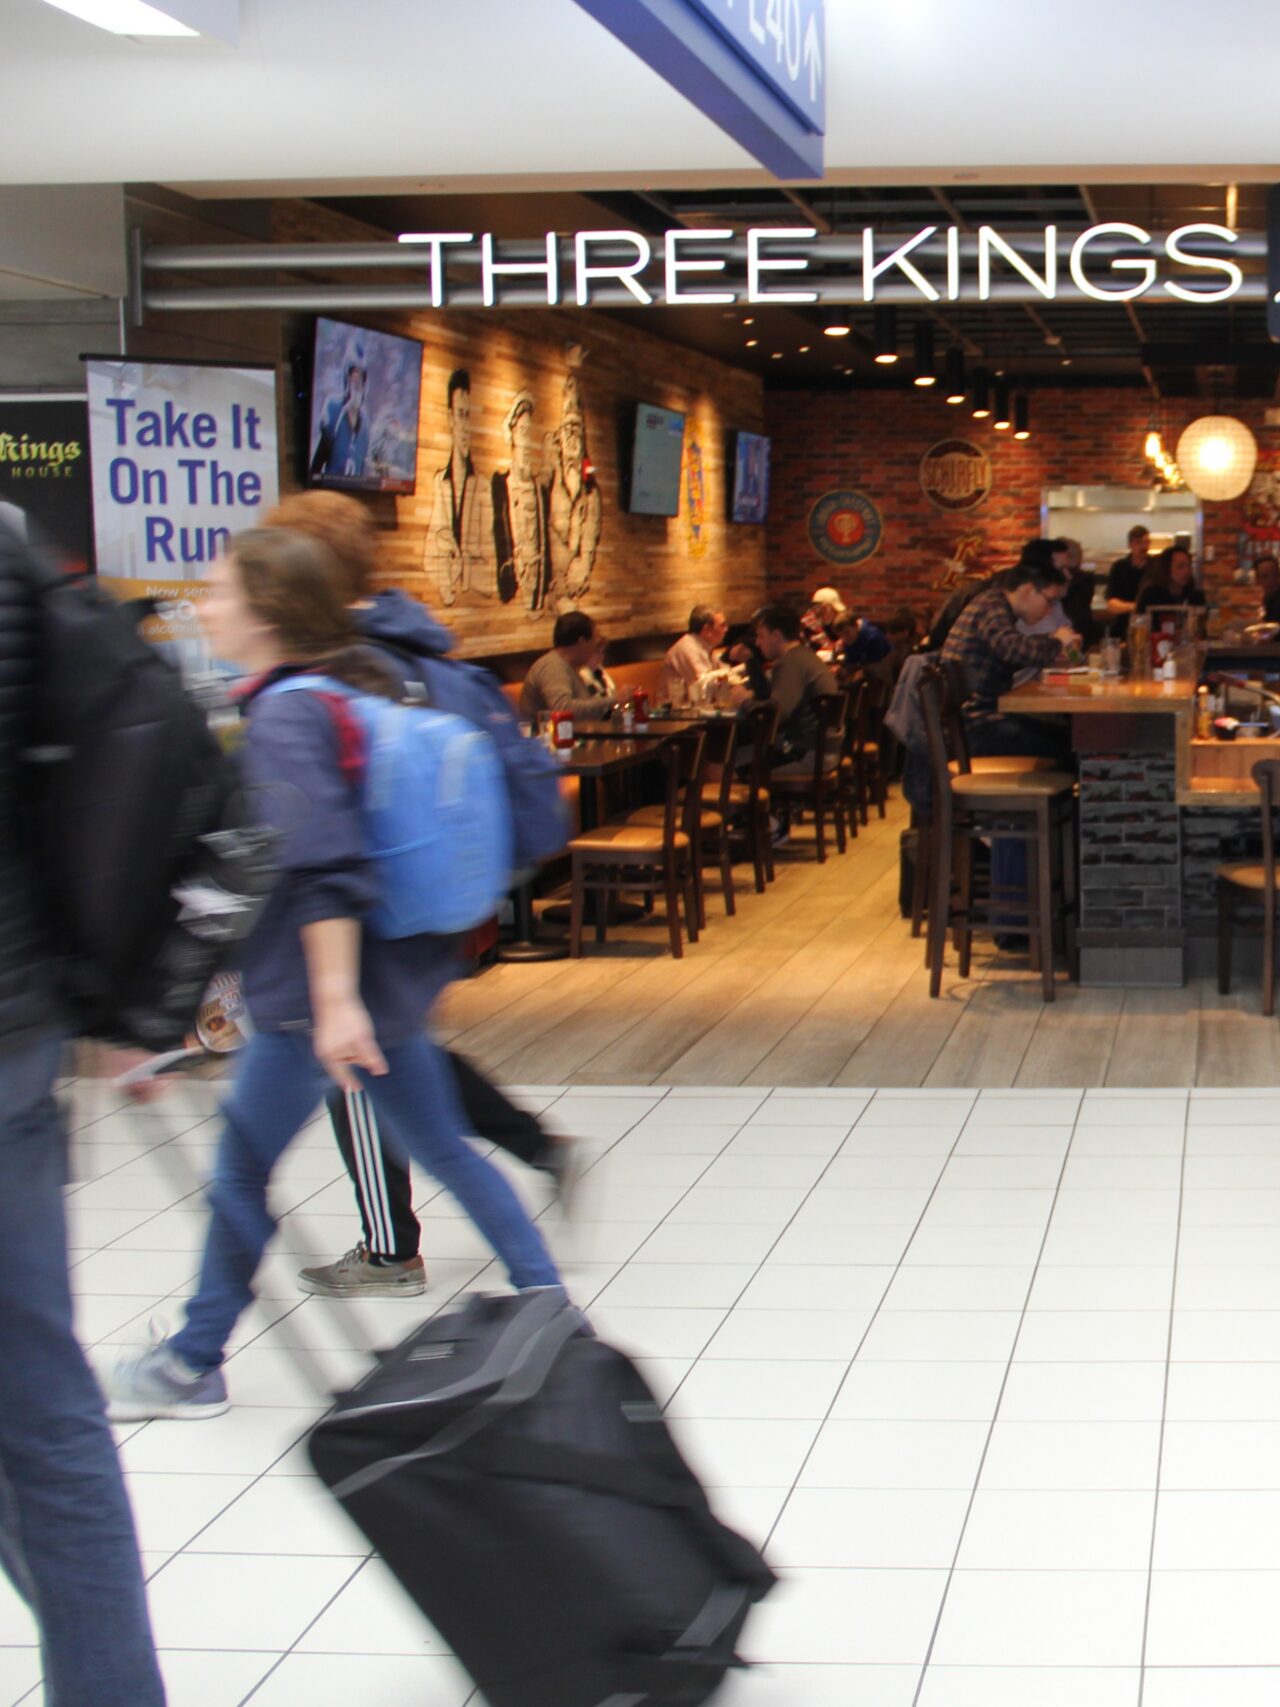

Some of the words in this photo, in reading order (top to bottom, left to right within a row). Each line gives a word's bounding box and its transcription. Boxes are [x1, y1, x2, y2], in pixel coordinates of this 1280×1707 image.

[397, 229, 818, 308] THREE
[861, 223, 1242, 302] KINGS
[106, 399, 217, 449] Take
[231, 403, 262, 450] It
[11, 466, 73, 478] HOUSE
[109, 457, 167, 505] On
[178, 459, 262, 506] The
[145, 516, 231, 563] Run
[146, 585, 178, 597] Now
